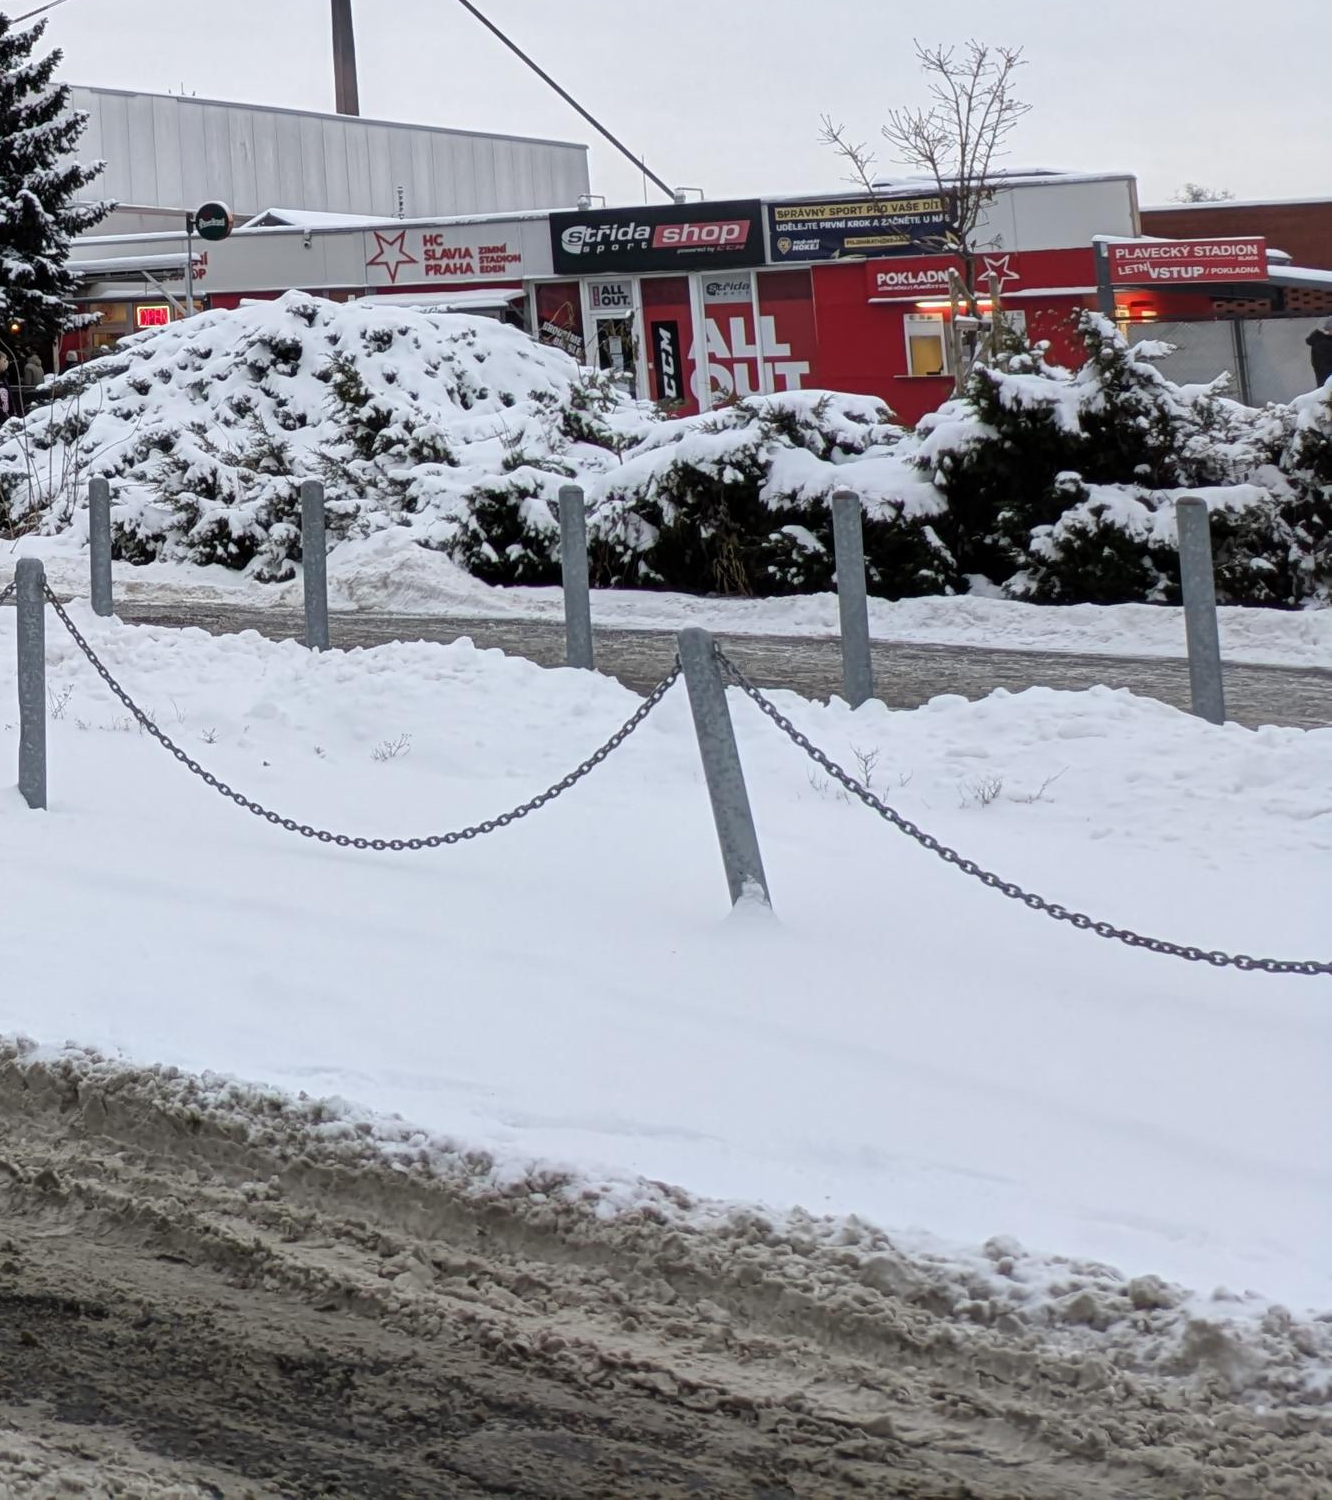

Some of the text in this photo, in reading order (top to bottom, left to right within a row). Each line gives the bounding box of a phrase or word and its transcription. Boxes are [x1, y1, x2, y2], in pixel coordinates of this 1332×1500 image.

[777, 206, 826, 219] SPRÁVNÝ
[829, 205, 863, 216] SPORT
[890, 200, 920, 212] VAŠE
[776, 221, 818, 232] UDĚLEJTE
[820, 219, 846, 229] PRVNÍ
[847, 219, 870, 228] KROK
[872, 219, 879, 227] A
[923, 215, 930, 224] U
[423, 234, 444, 247] HC
[662, 223, 740, 245] shop
[424, 247, 473, 262] SLAVIA
[583, 242, 647, 254] sport
[1115, 243, 1258, 259] PLAVECKÝ STADION
[479, 254, 521, 264] STADION
[425, 261, 474, 277] PRAHA
[479, 263, 505, 274] EDEN
[1149, 266, 1204, 279] VSTUP
[1211, 266, 1260, 275] POKLADNA
[877, 269, 949, 286] POKLADN
[601, 284, 624, 296] ALL
[139, 308, 168, 326] OPEN
[688, 315, 791, 359] ALL
[659, 327, 677, 399] CCM
[690, 361, 810, 402] OUT
